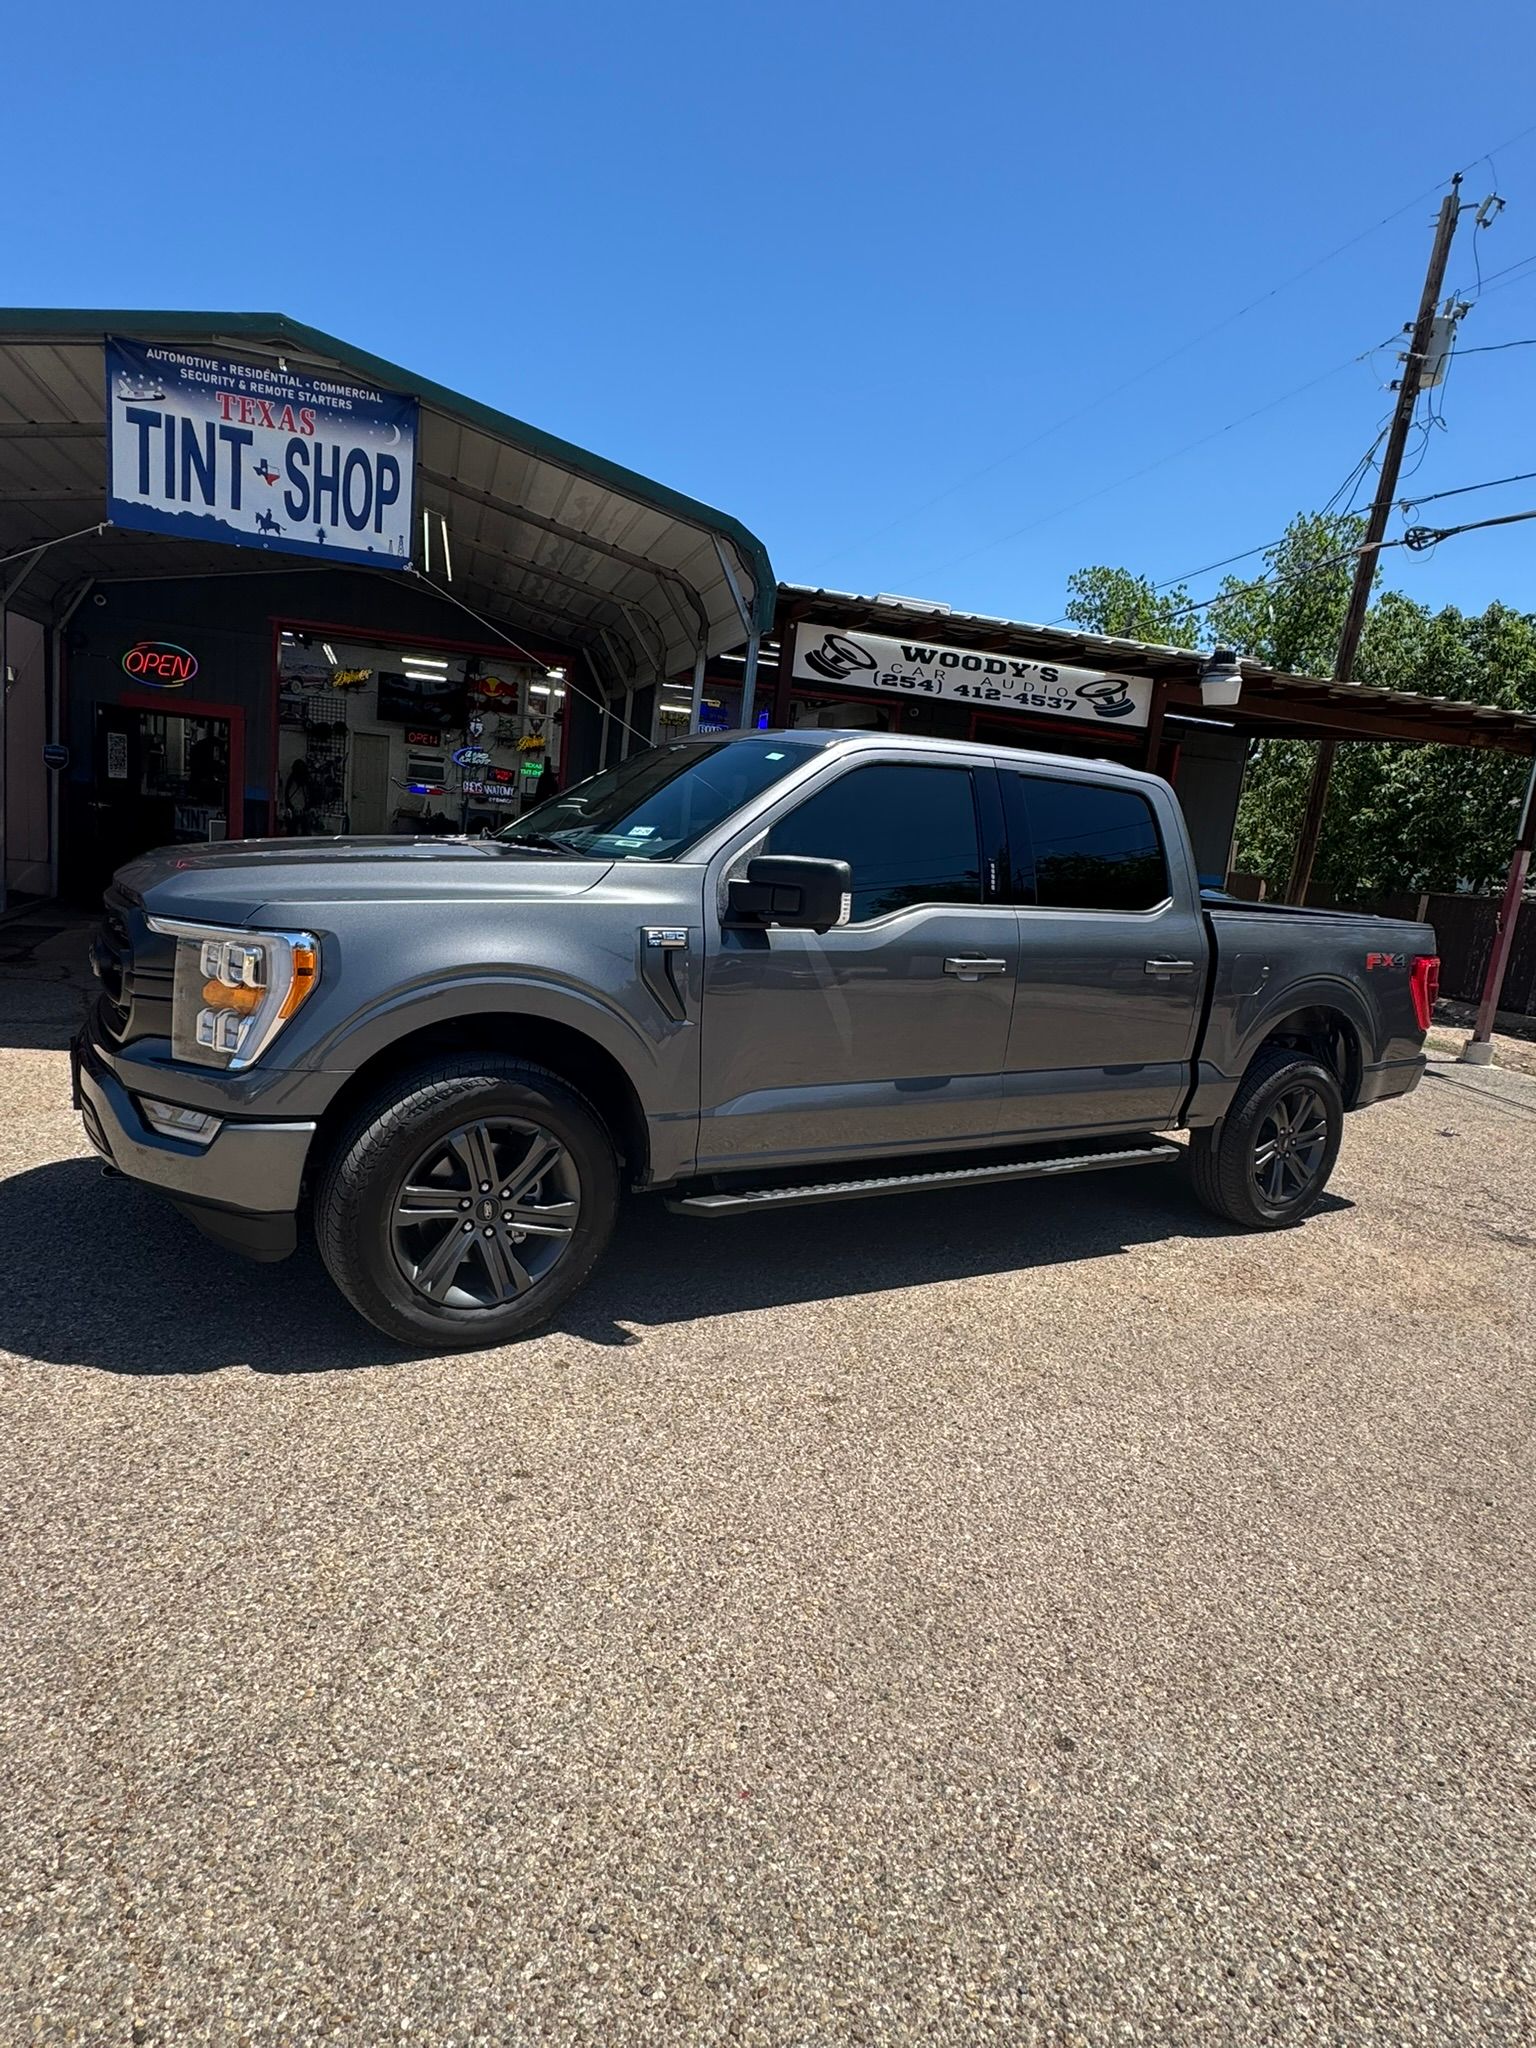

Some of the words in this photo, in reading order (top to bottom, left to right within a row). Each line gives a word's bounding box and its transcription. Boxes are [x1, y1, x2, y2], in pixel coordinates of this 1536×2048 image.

[146, 348, 219, 371] AUTOMOTIVE
[313, 380, 383, 403] COMMERCIAL
[180, 368, 235, 388] SECURITY
[238, 379, 246, 390] &
[250, 382, 294, 399] REMOTE
[298, 391, 353, 410] STARTERS
[215, 391, 316, 436] TEXAS
[126, 406, 254, 511] TINT
[283, 436, 400, 534] SHOP
[126, 651, 191, 677] OPEN
[890, 663, 946, 680] CAR
[980, 676, 1068, 697] AUDIO
[900, 645, 1059, 683] WOODY'S
[873, 670, 942, 695] (254)
[953, 684, 1077, 711] 412-4537
[408, 731, 438, 745] OPEN
[179, 808, 208, 829] TINT
[648, 931, 686, 940] F-150
[1366, 952, 1407, 972] FX4
